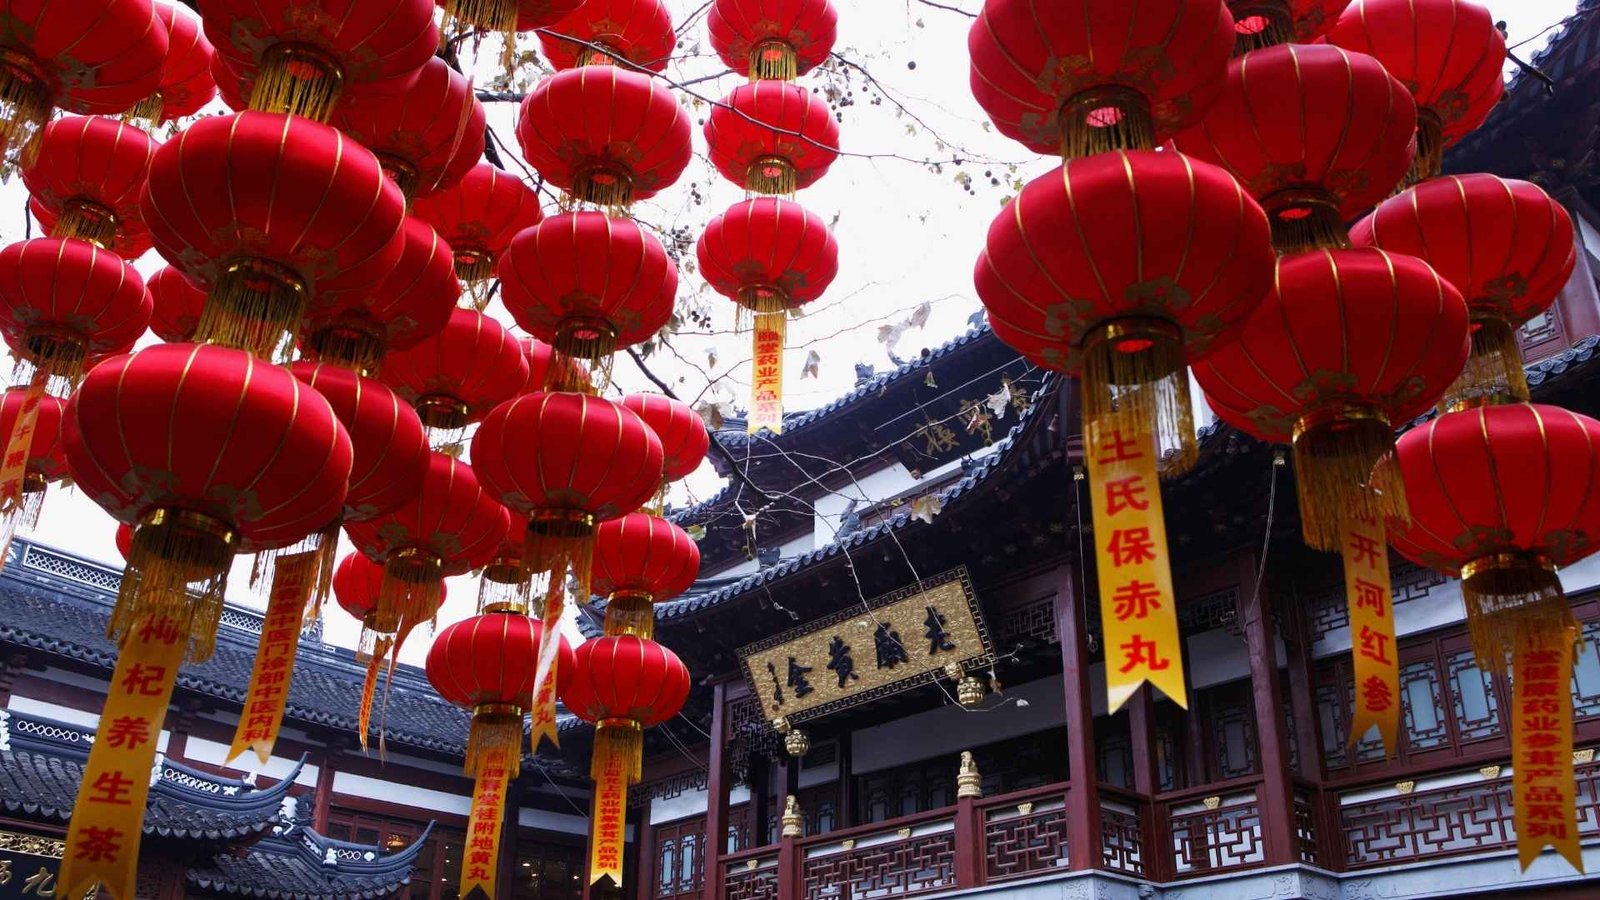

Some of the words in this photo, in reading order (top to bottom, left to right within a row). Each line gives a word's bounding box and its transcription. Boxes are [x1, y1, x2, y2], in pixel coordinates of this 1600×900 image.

[1350, 512, 1392, 712] 开河红参
[1520, 638, 1567, 840] 堂健康药业参茸产品系列
